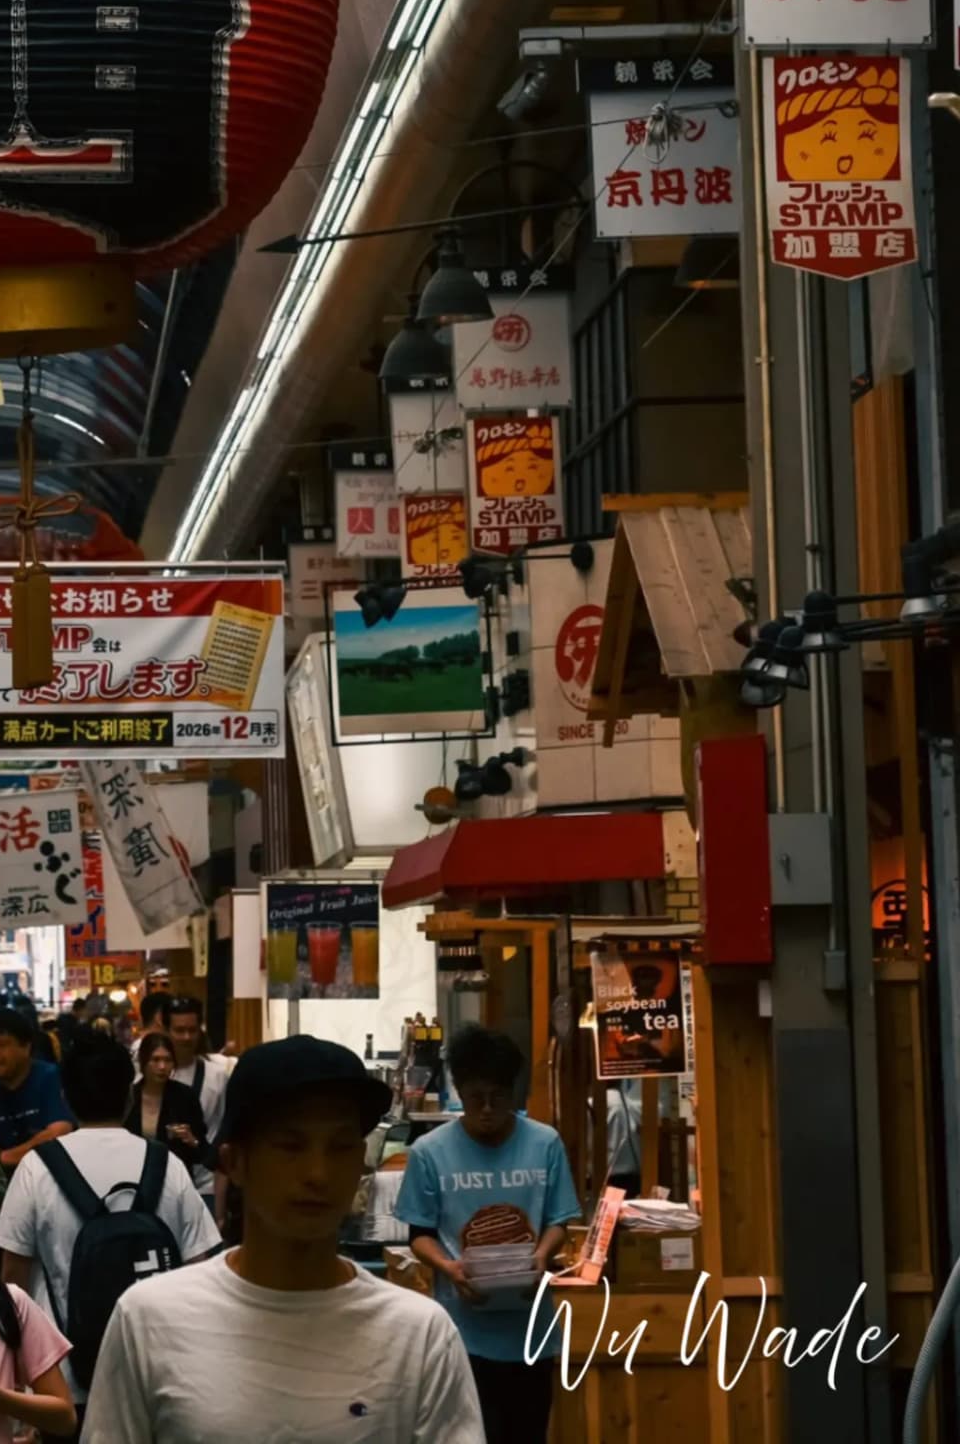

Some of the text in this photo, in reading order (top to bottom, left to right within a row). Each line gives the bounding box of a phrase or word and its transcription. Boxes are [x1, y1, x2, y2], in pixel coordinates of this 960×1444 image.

[777, 61, 858, 94] クロモン
[605, 166, 733, 207] 京丹波
[788, 183, 888, 203] フレッシュ
[779, 203, 904, 227] STAMP
[782, 231, 906, 260] 加盟店
[477, 422, 526, 443] クロモン
[403, 499, 451, 517] クロモン
[484, 498, 547, 510] フレッシュ
[478, 509, 556, 526] STAMP
[479, 527, 558, 547] 加盟店
[413, 563, 462, 576] フレッシ
[2, 718, 170, 743] 満点カードご利用終了
[557, 723, 595, 741] SINCE
[270, 903, 315, 920] Original
[319, 899, 347, 913] Fruit
[597, 985, 637, 997] Black
[606, 997, 667, 1014] soybean
[642, 1012, 680, 1031] tea
[451, 1171, 494, 1192] JUST
[500, 1168, 548, 1189] LOVE
